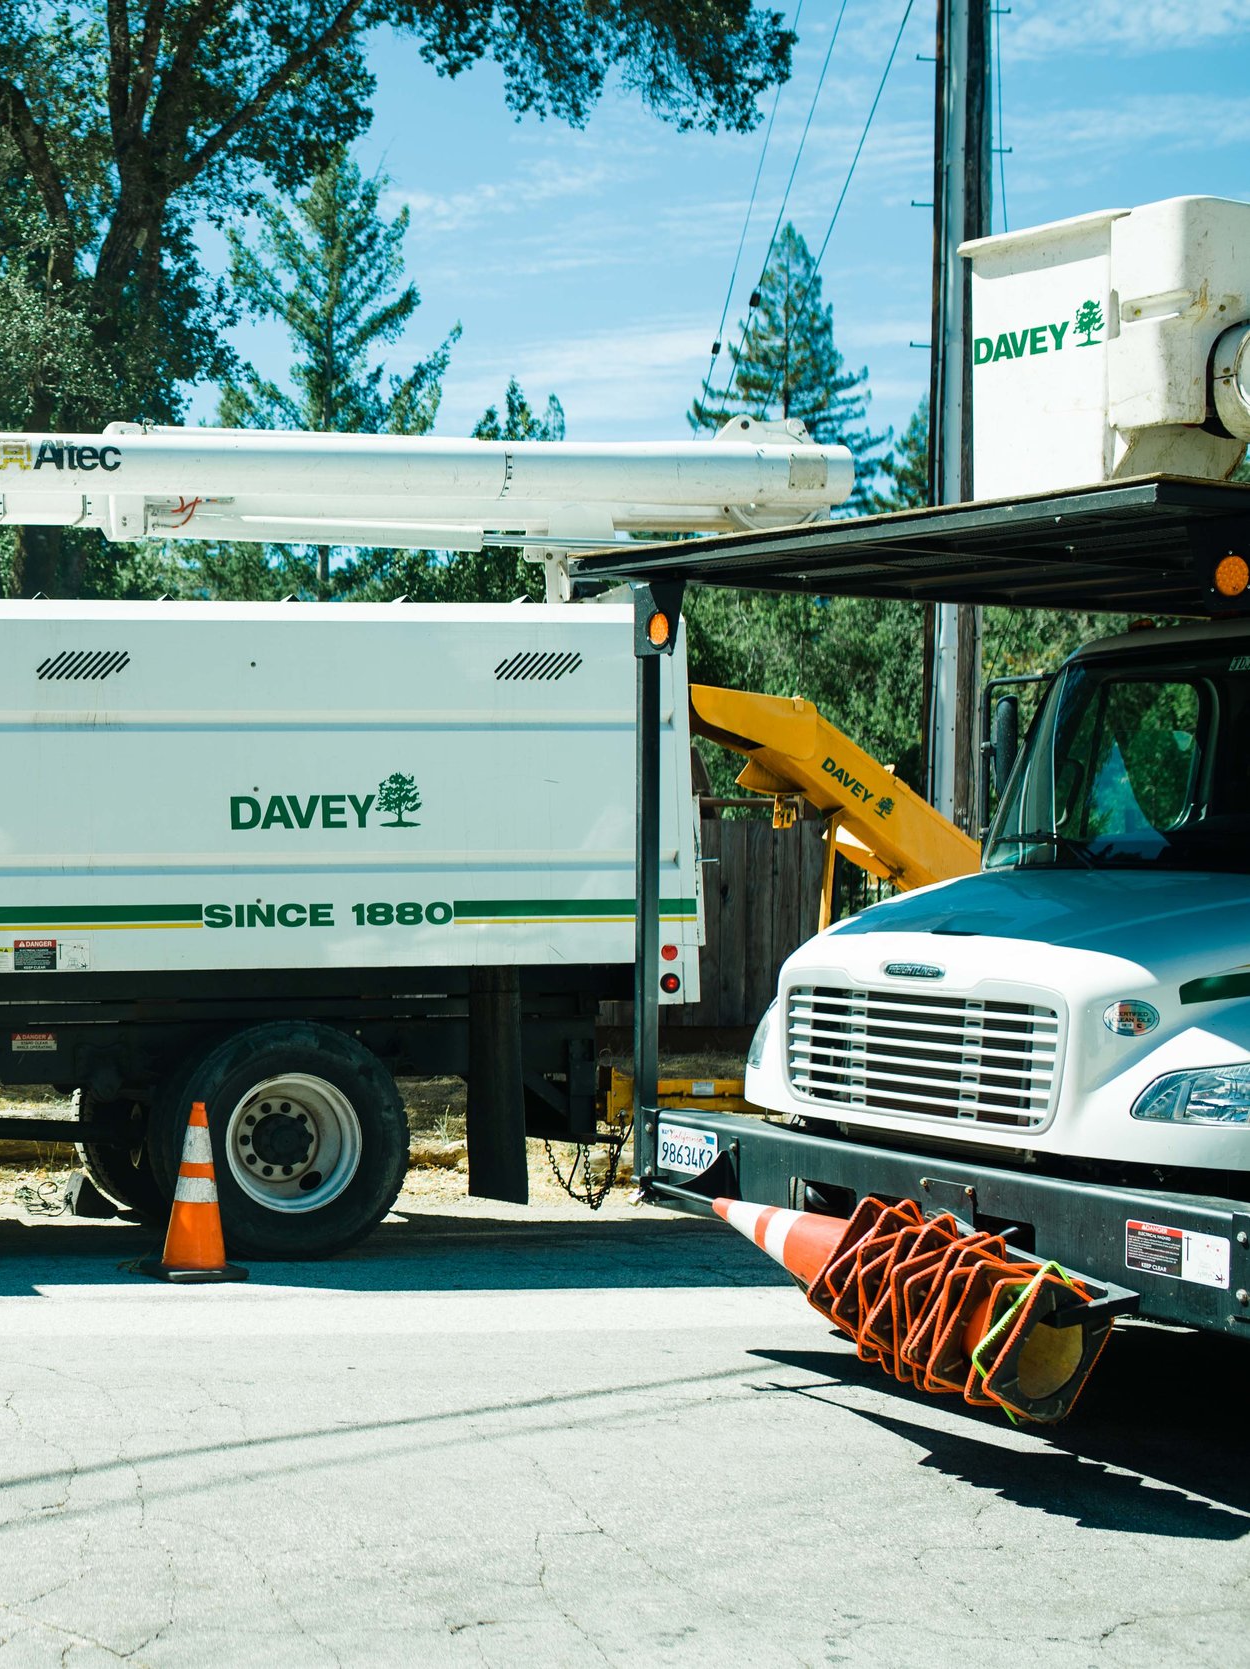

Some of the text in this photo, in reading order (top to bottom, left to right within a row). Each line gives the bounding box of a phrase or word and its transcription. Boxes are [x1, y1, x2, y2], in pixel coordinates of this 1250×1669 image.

[973, 320, 1070, 366] DAVEY
[33, 439, 122, 472] Altec
[821, 756, 874, 803] DAVEY
[230, 794, 376, 830] DAVEY
[204, 901, 453, 929] SINCE 1880
[1145, 1224, 1168, 1234] DANGER
[1152, 1264, 1167, 1272] CLEAR
